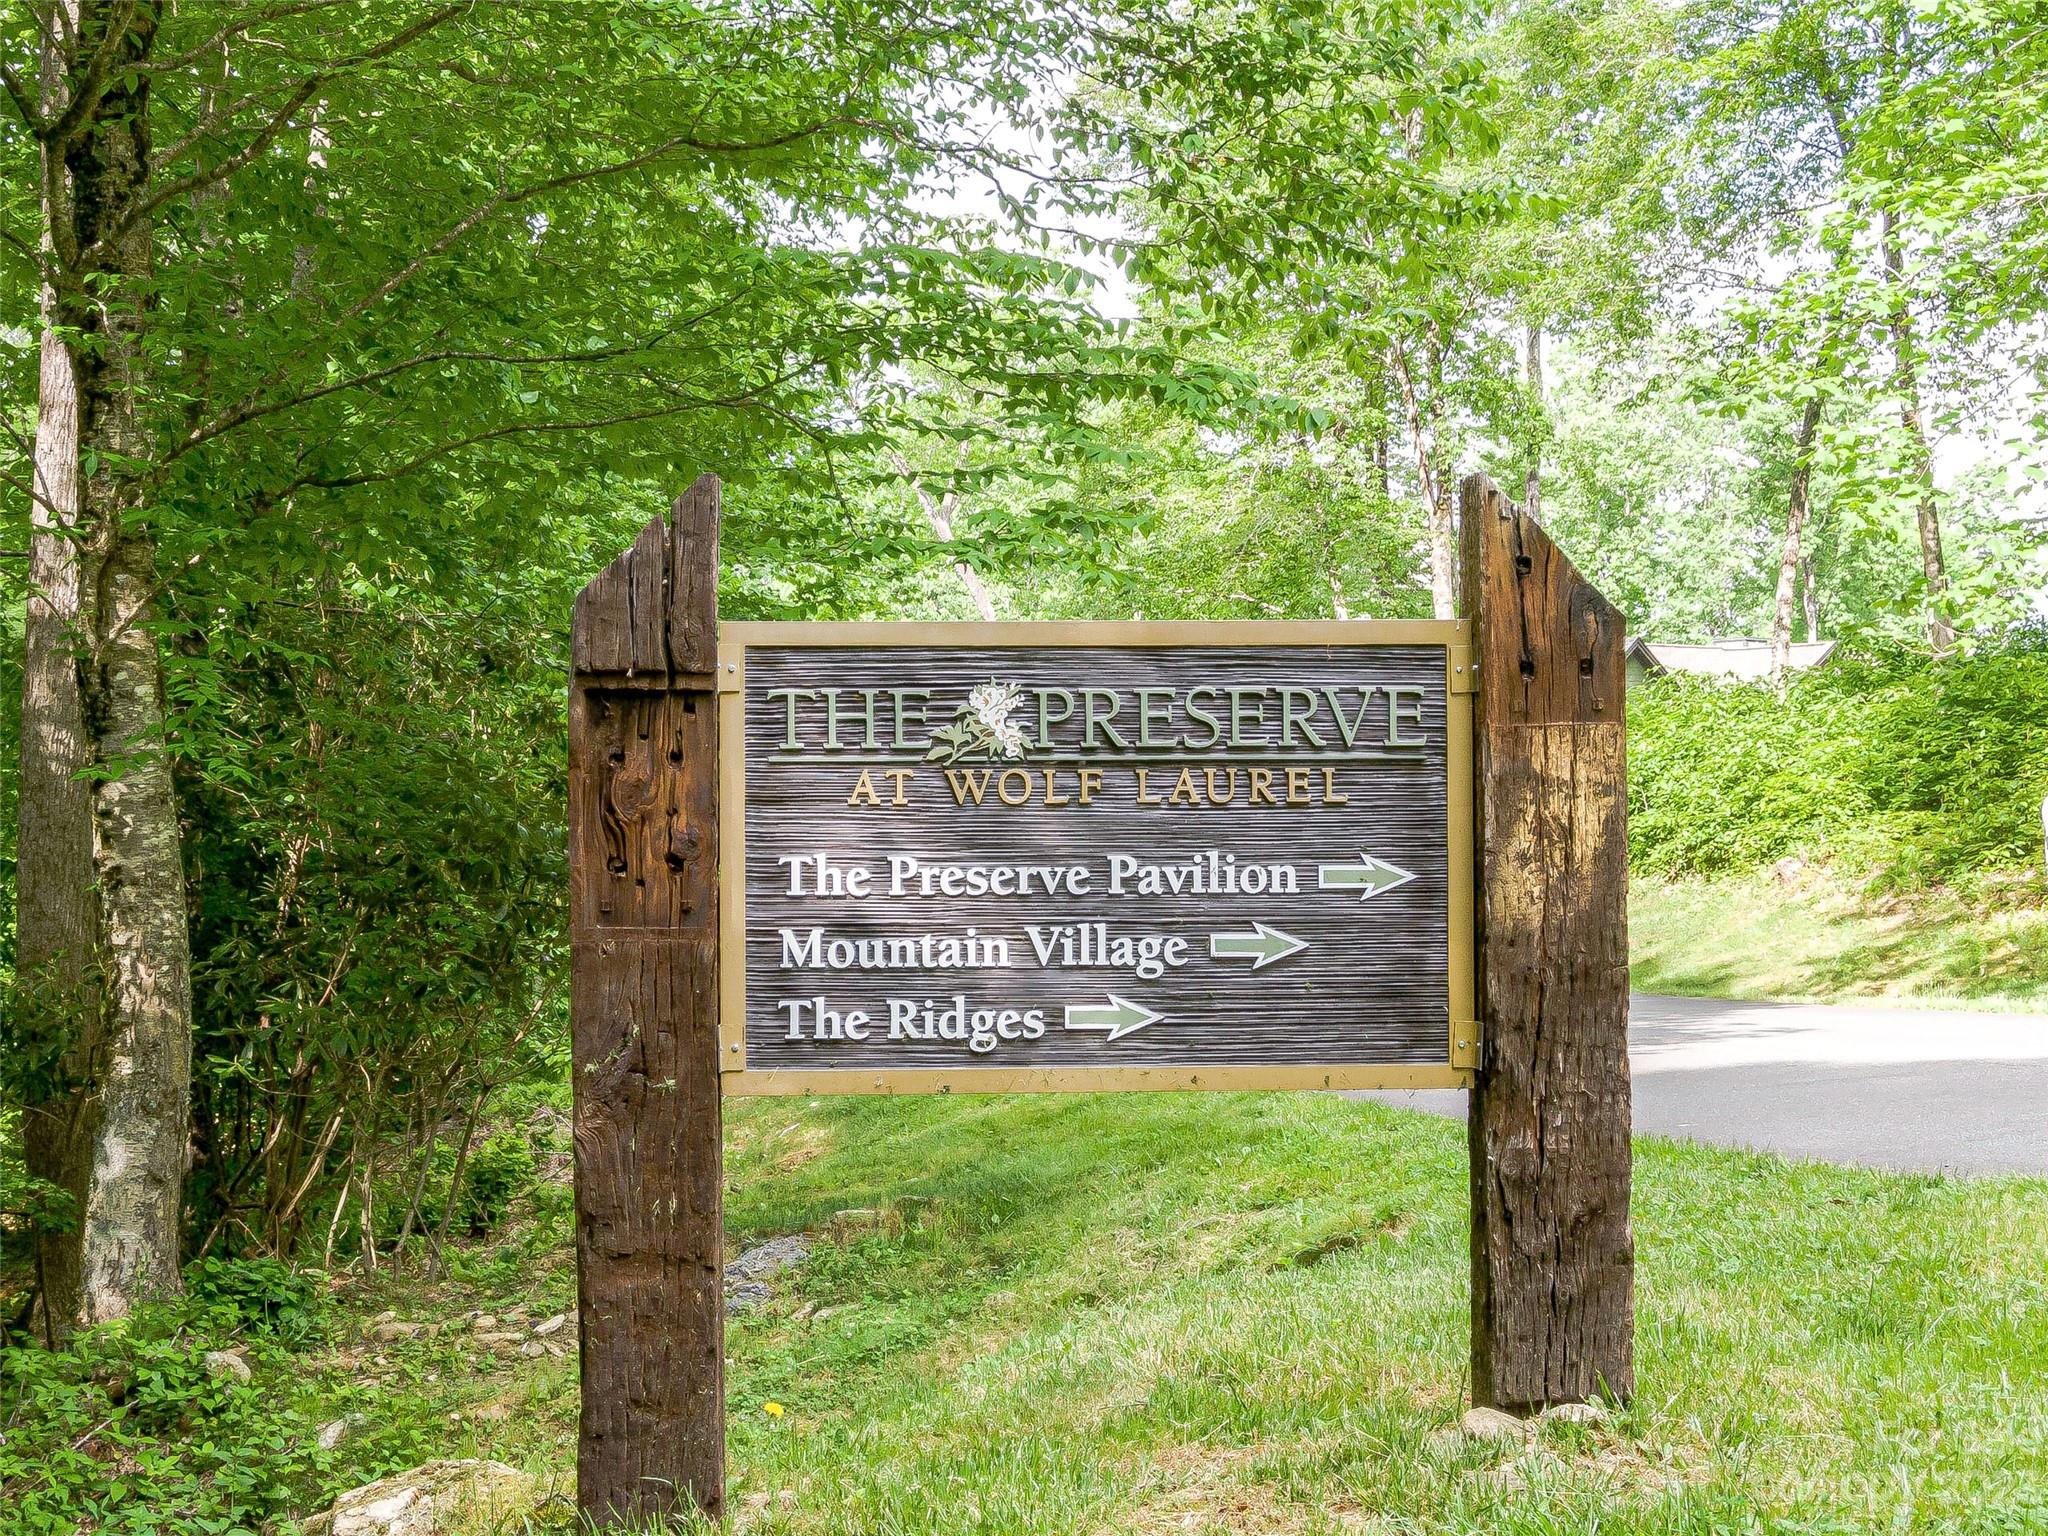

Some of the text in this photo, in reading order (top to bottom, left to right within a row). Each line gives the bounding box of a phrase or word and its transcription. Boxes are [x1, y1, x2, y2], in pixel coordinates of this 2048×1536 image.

[767, 686, 1427, 750] THE PRESERVE
[847, 767, 1349, 806] AT WOLF LAUREL
[778, 850, 1300, 897] The Preserve Pavilion
[778, 922, 1188, 979] Mountain Village
[778, 995, 1045, 1052] The Ridges
